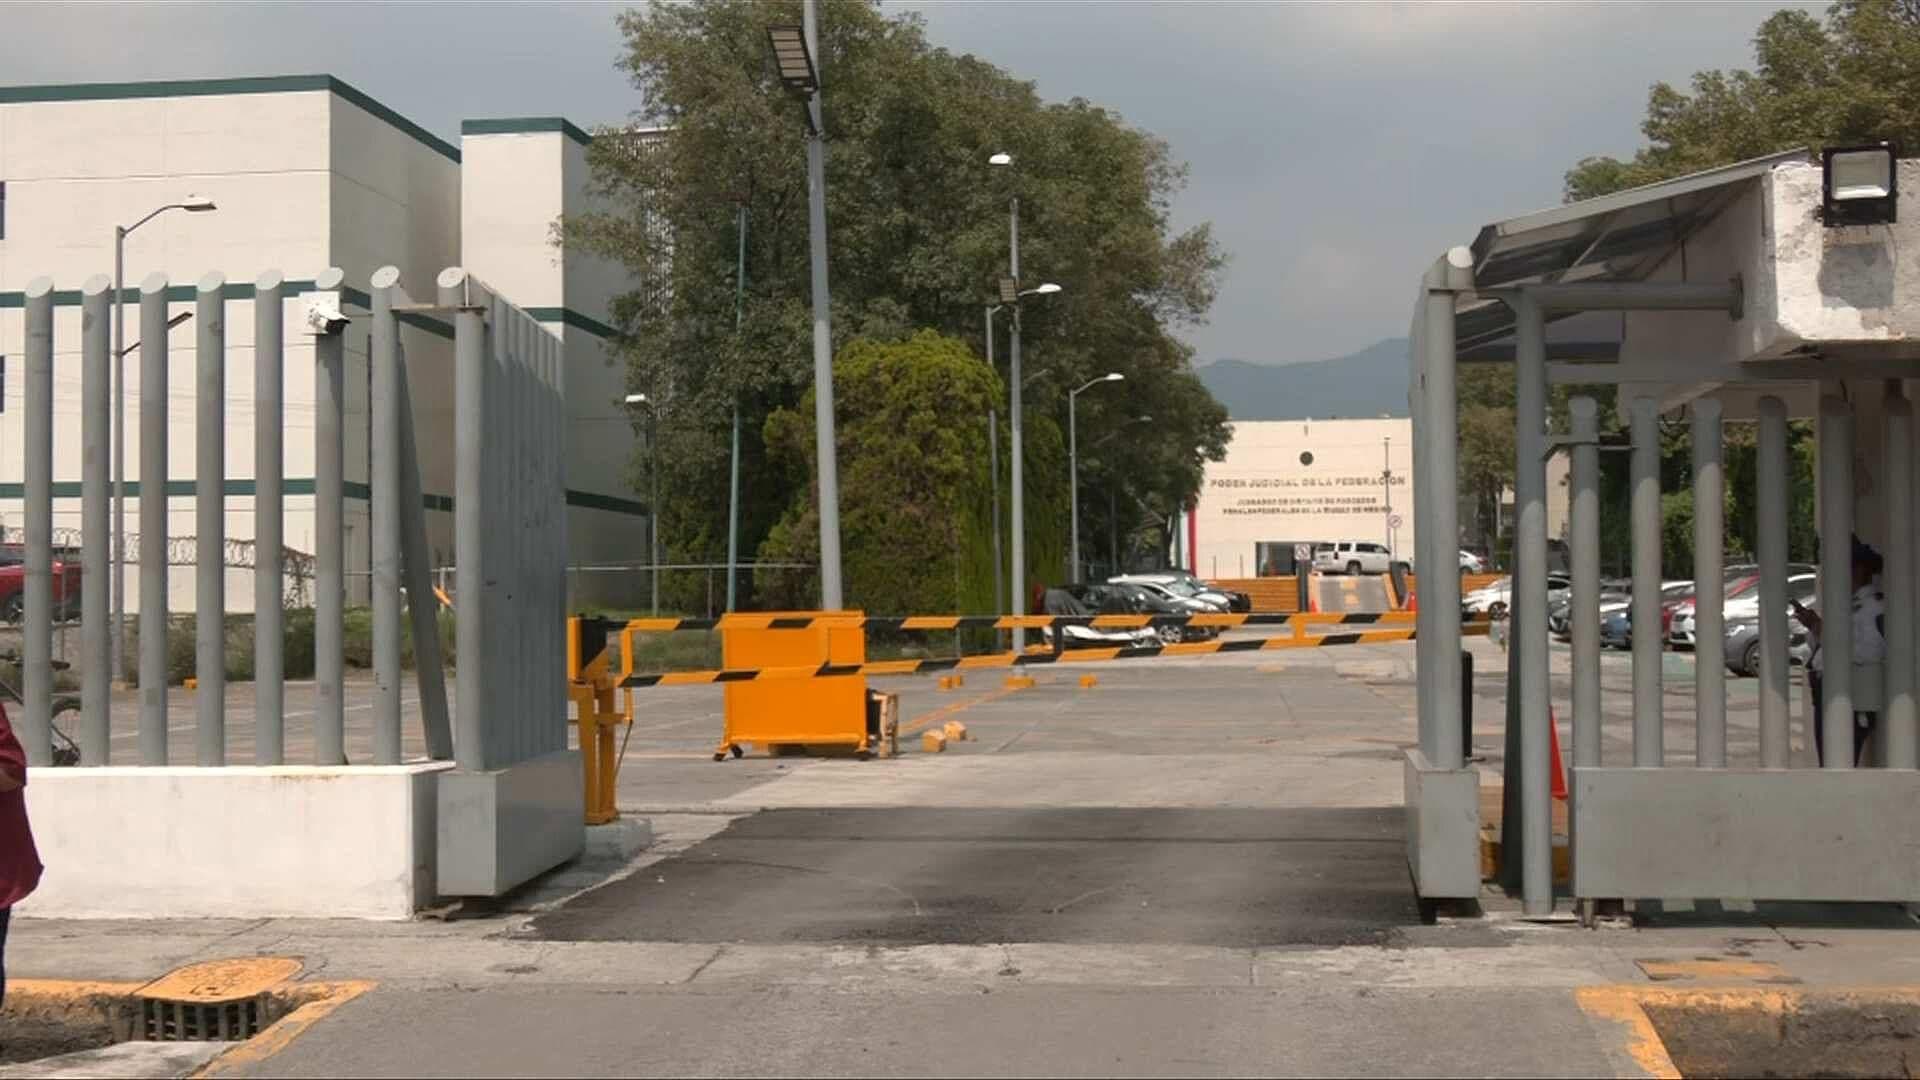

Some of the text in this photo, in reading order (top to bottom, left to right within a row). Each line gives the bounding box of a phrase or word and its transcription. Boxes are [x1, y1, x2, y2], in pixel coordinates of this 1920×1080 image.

[1211, 477, 1405, 488] PODER JUDICIAL DE LA FEDERACON
